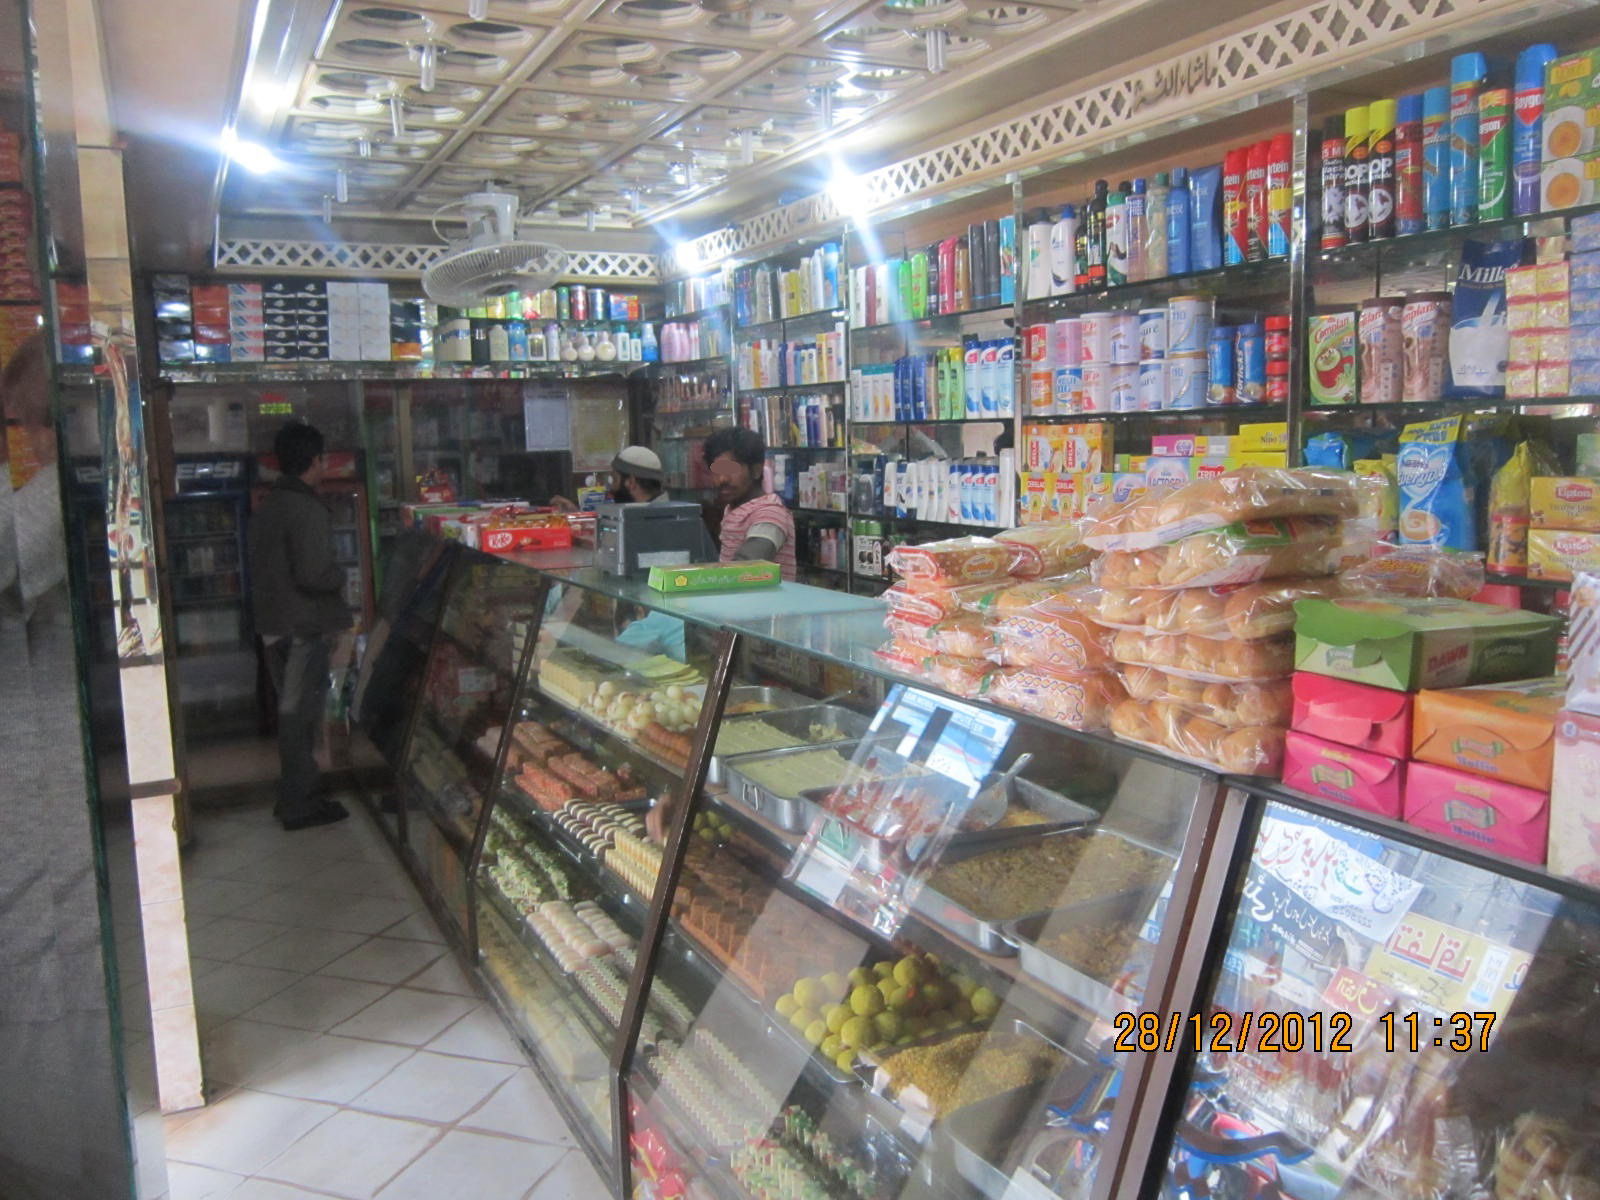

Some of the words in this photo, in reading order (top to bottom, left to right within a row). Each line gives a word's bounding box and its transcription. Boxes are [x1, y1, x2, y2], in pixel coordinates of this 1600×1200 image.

[1369, 157, 1393, 175] OP
[176, 462, 240, 479] EPSI
[1557, 487, 1593, 500] Lipton
